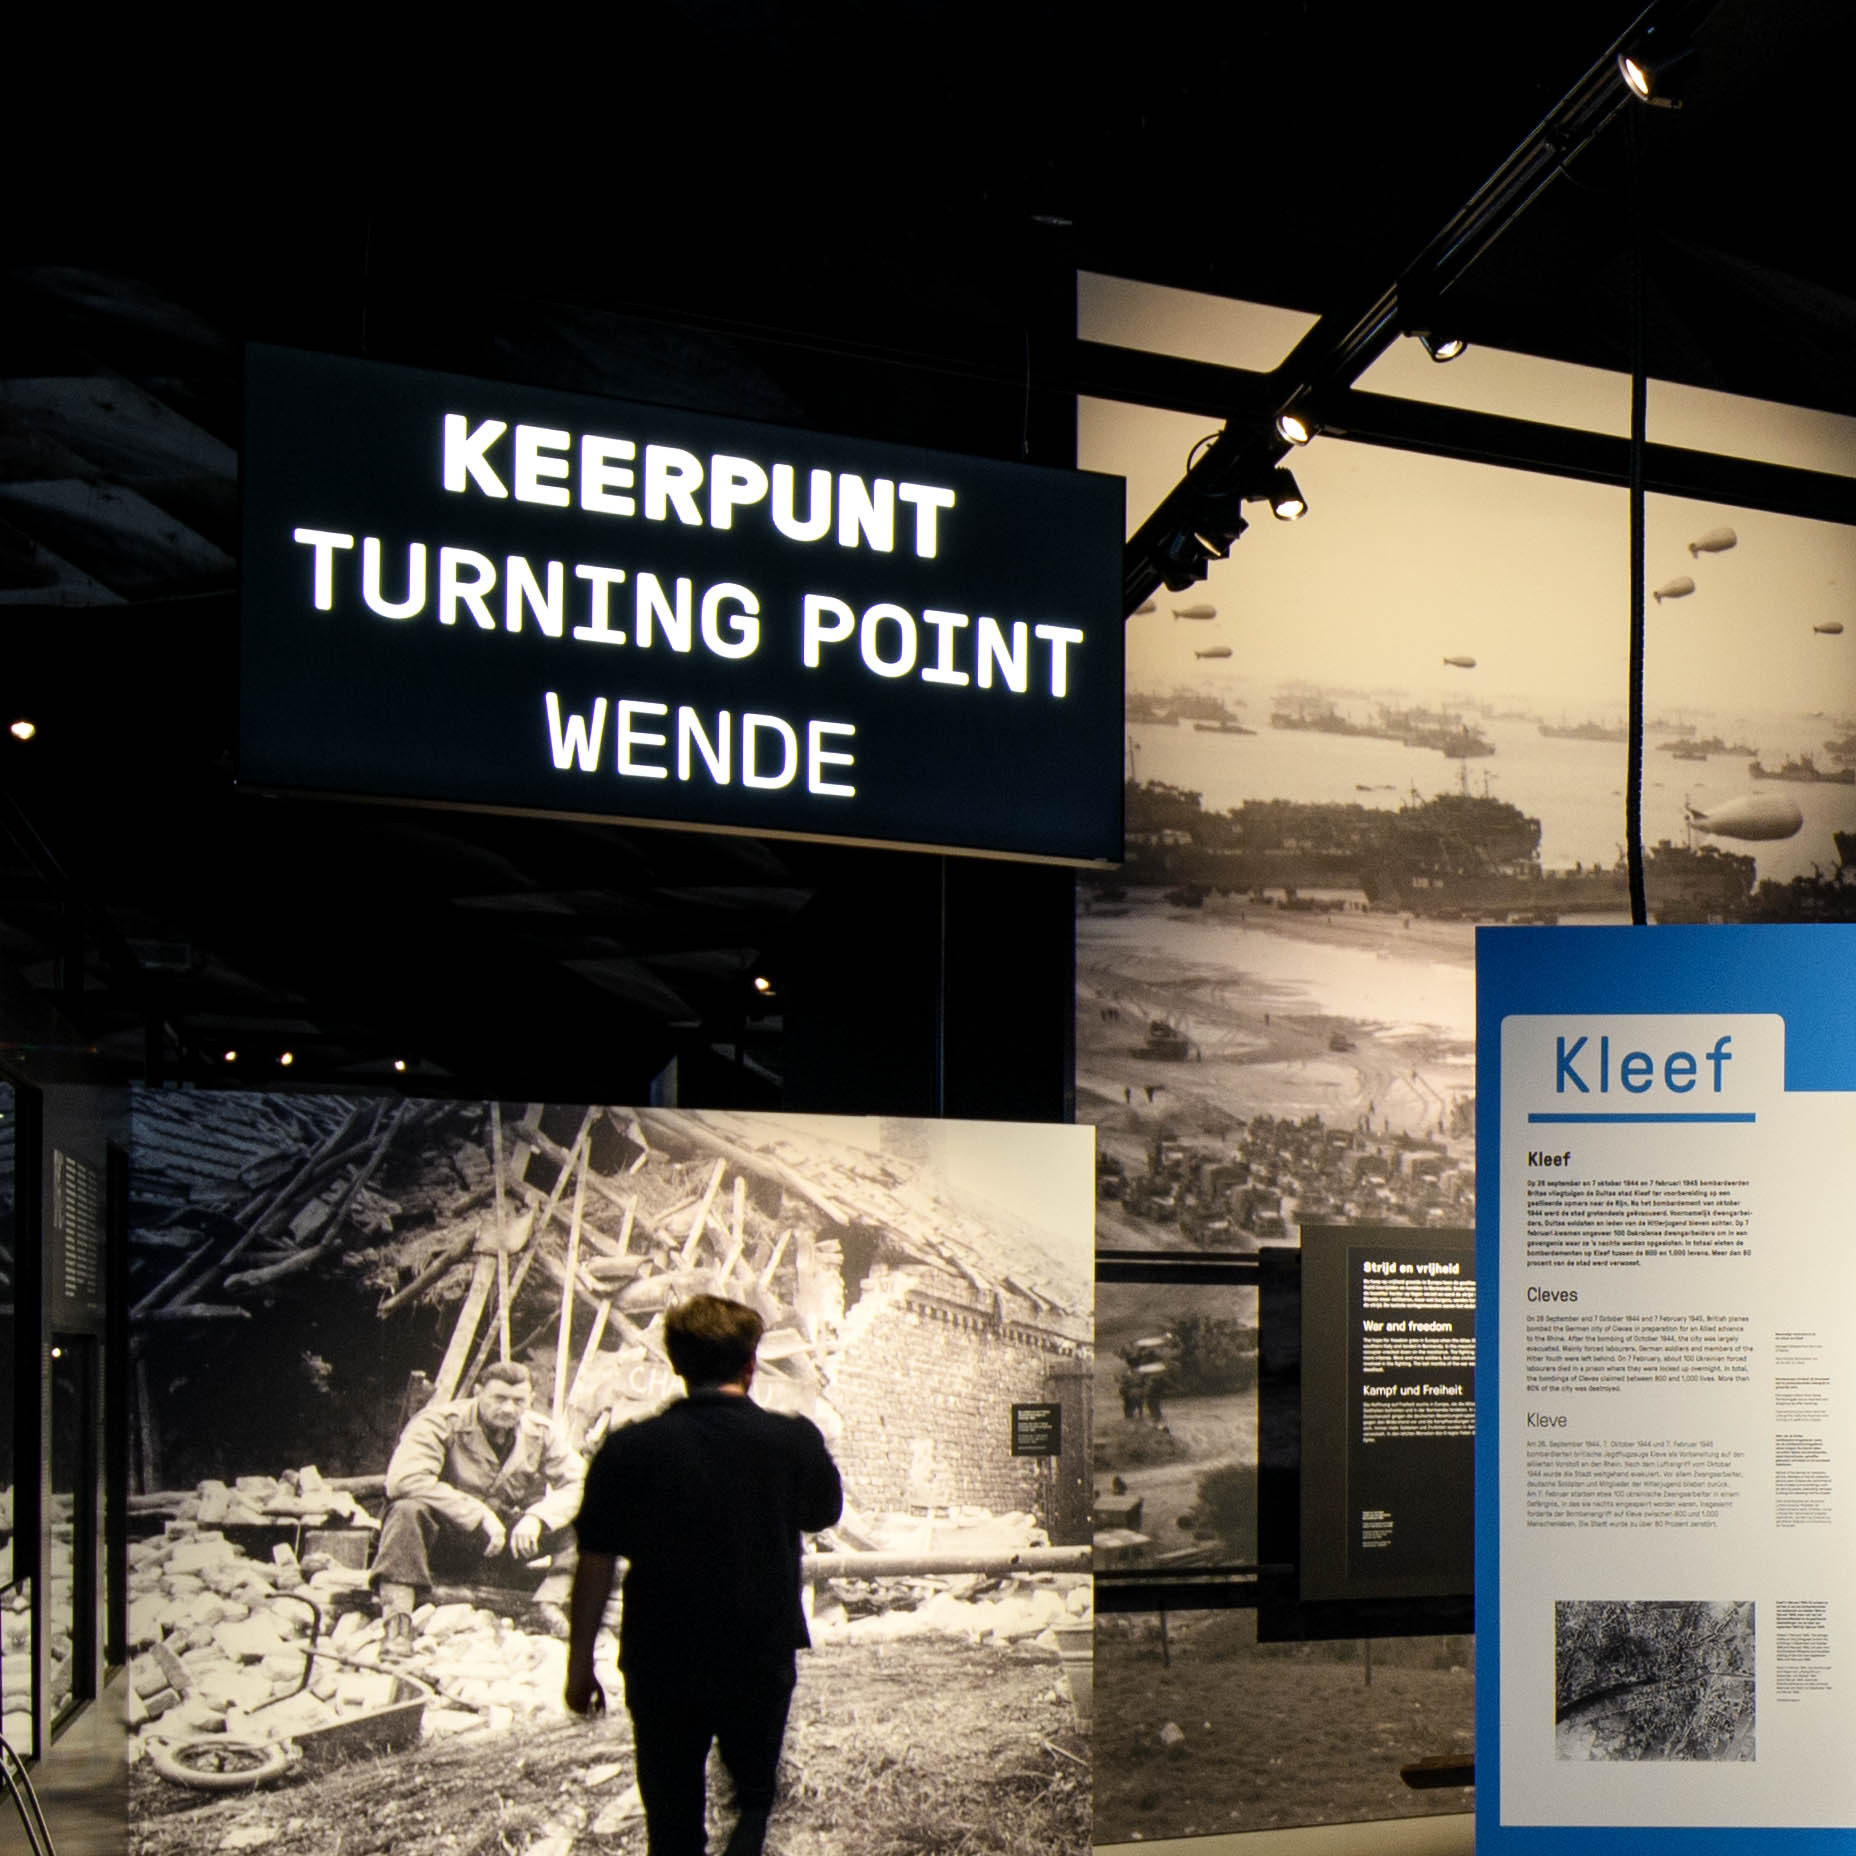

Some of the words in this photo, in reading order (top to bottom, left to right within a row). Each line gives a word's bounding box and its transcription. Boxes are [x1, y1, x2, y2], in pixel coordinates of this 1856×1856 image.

[443, 412, 956, 560] KEERPUNT
[293, 526, 762, 662] TURNING
[803, 594, 1085, 700] POINT
[545, 691, 858, 799] WENDE
[1555, 1035, 1733, 1093] Kleef
[1527, 1151, 1572, 1167] Kleef
[1363, 1261, 1397, 1276] Strijd
[1399, 1264, 1414, 1273] en
[1416, 1263, 1460, 1277] vrijheid
[1527, 1286, 1579, 1302] Cleves
[1363, 1320, 1384, 1332] War
[1386, 1321, 1406, 1332] and
[1408, 1320, 1453, 1332] freedom
[1363, 1384, 1397, 1398] Kampf
[1400, 1385, 1420, 1396] und
[1422, 1384, 1463, 1396] Freiheit
[1527, 1412, 1568, 1428] Kleve
